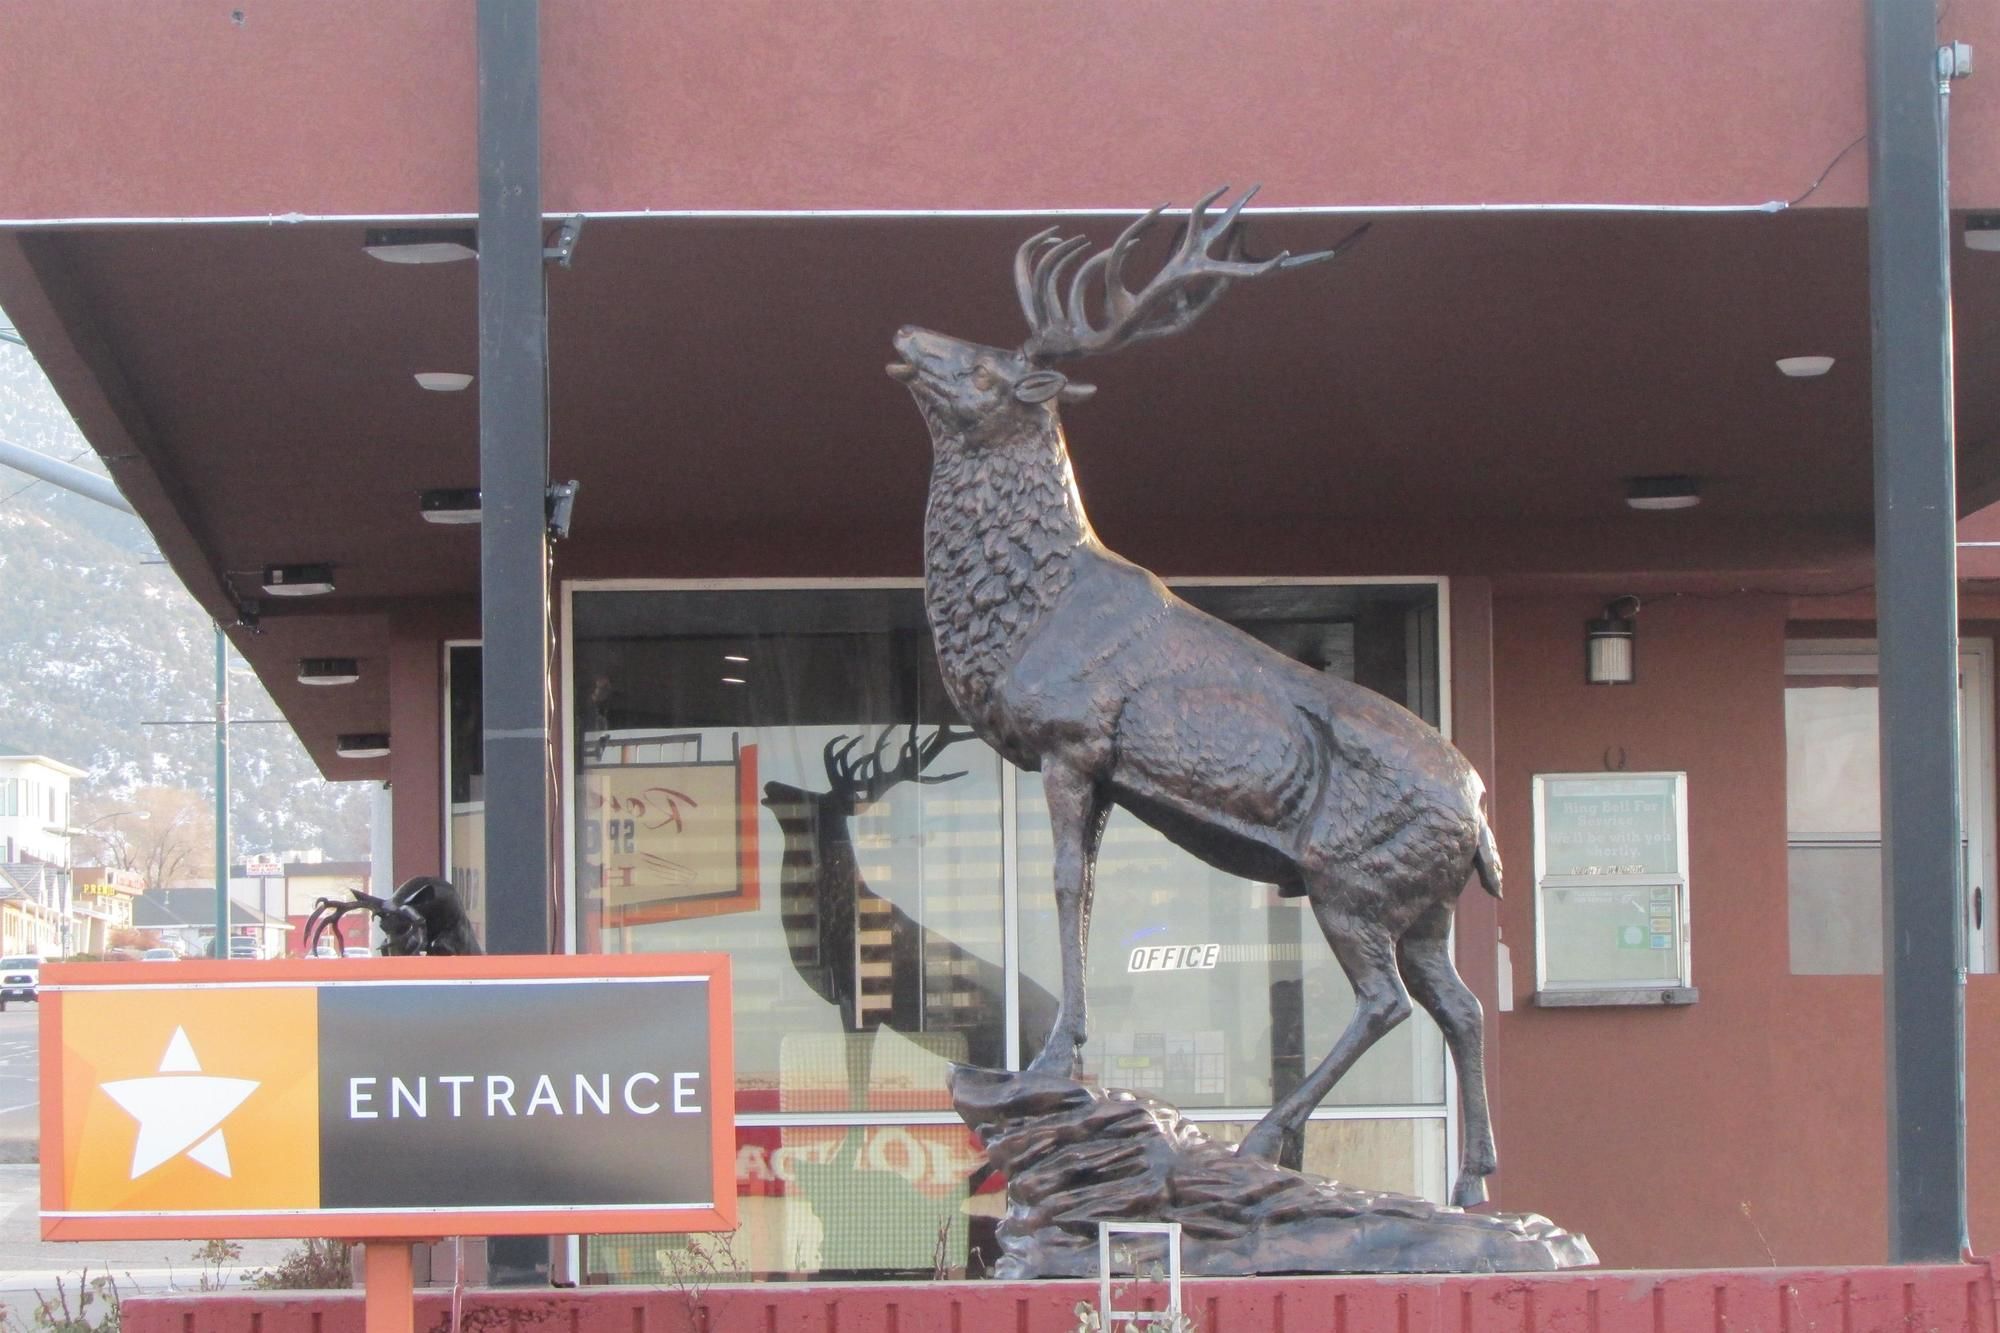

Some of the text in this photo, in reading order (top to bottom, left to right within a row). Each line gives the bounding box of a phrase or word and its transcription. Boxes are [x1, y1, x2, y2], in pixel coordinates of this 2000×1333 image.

[1563, 800, 1658, 815] Ring Bell For
[1577, 815, 1633, 826] Service
[1609, 831, 1640, 843] with
[1644, 832, 1672, 845] you
[1130, 944, 1219, 971] OFFICE
[349, 1072, 702, 1120] ENTRANCE
